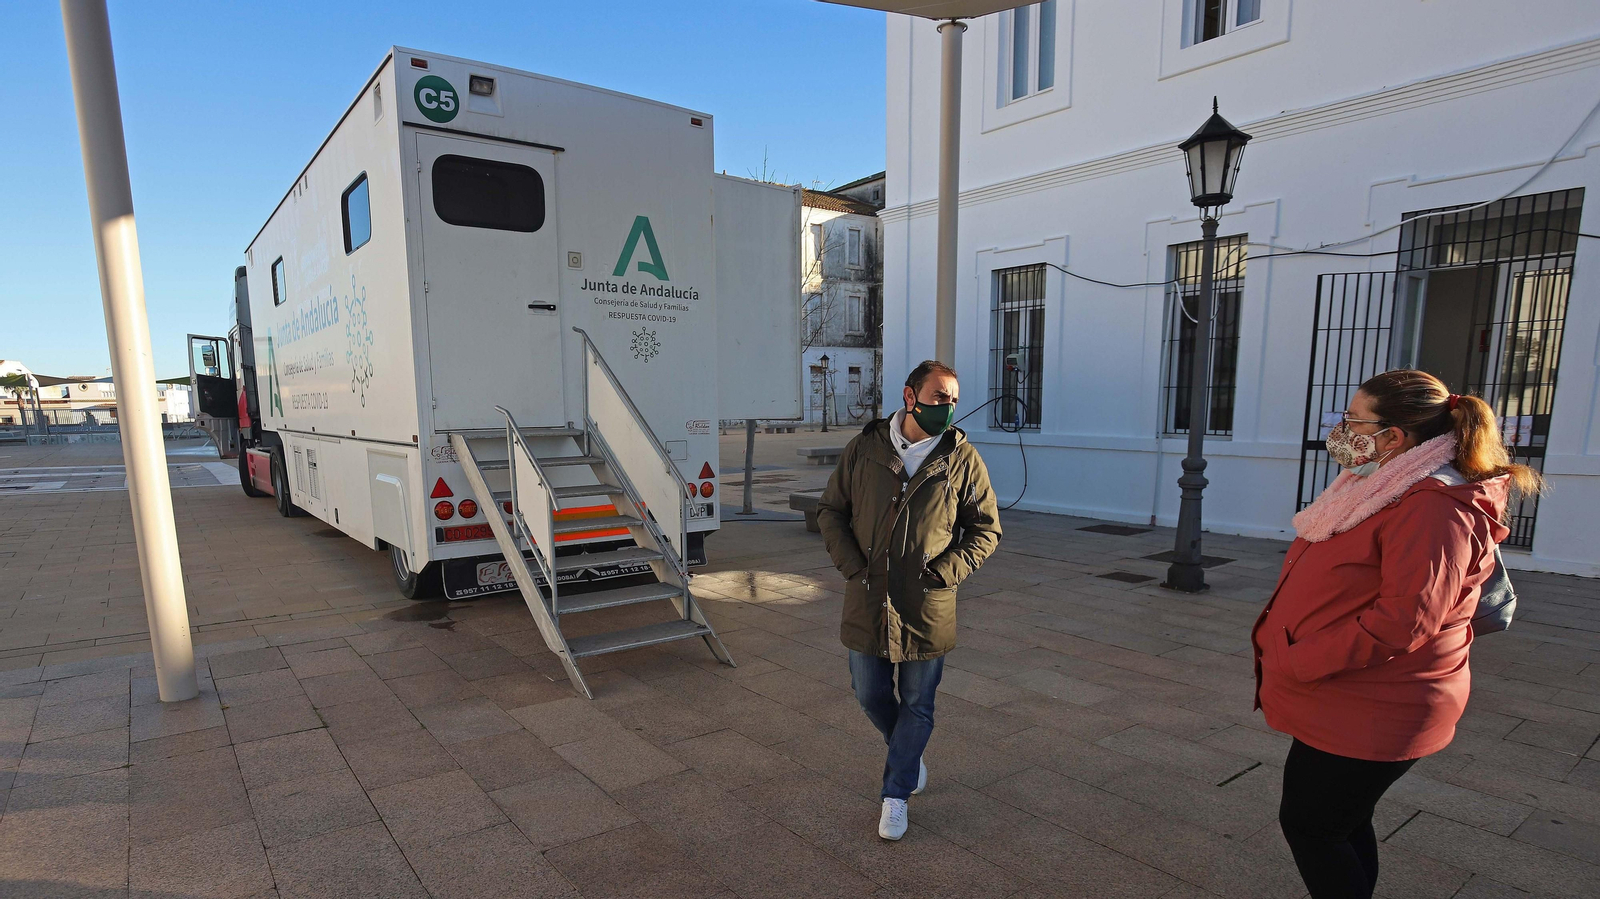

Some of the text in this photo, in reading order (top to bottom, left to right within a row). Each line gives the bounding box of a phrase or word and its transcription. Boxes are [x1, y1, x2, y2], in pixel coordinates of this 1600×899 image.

[418, 86, 456, 113] C5
[581, 278, 699, 300] Junta de Andalucía
[292, 311, 301, 342] de
[300, 284, 340, 339] Andalucía
[630, 299, 639, 307] de
[639, 301, 658, 309] Salud
[663, 303, 689, 311] Familias
[608, 311, 677, 323] RESPUESTA COVID-19
